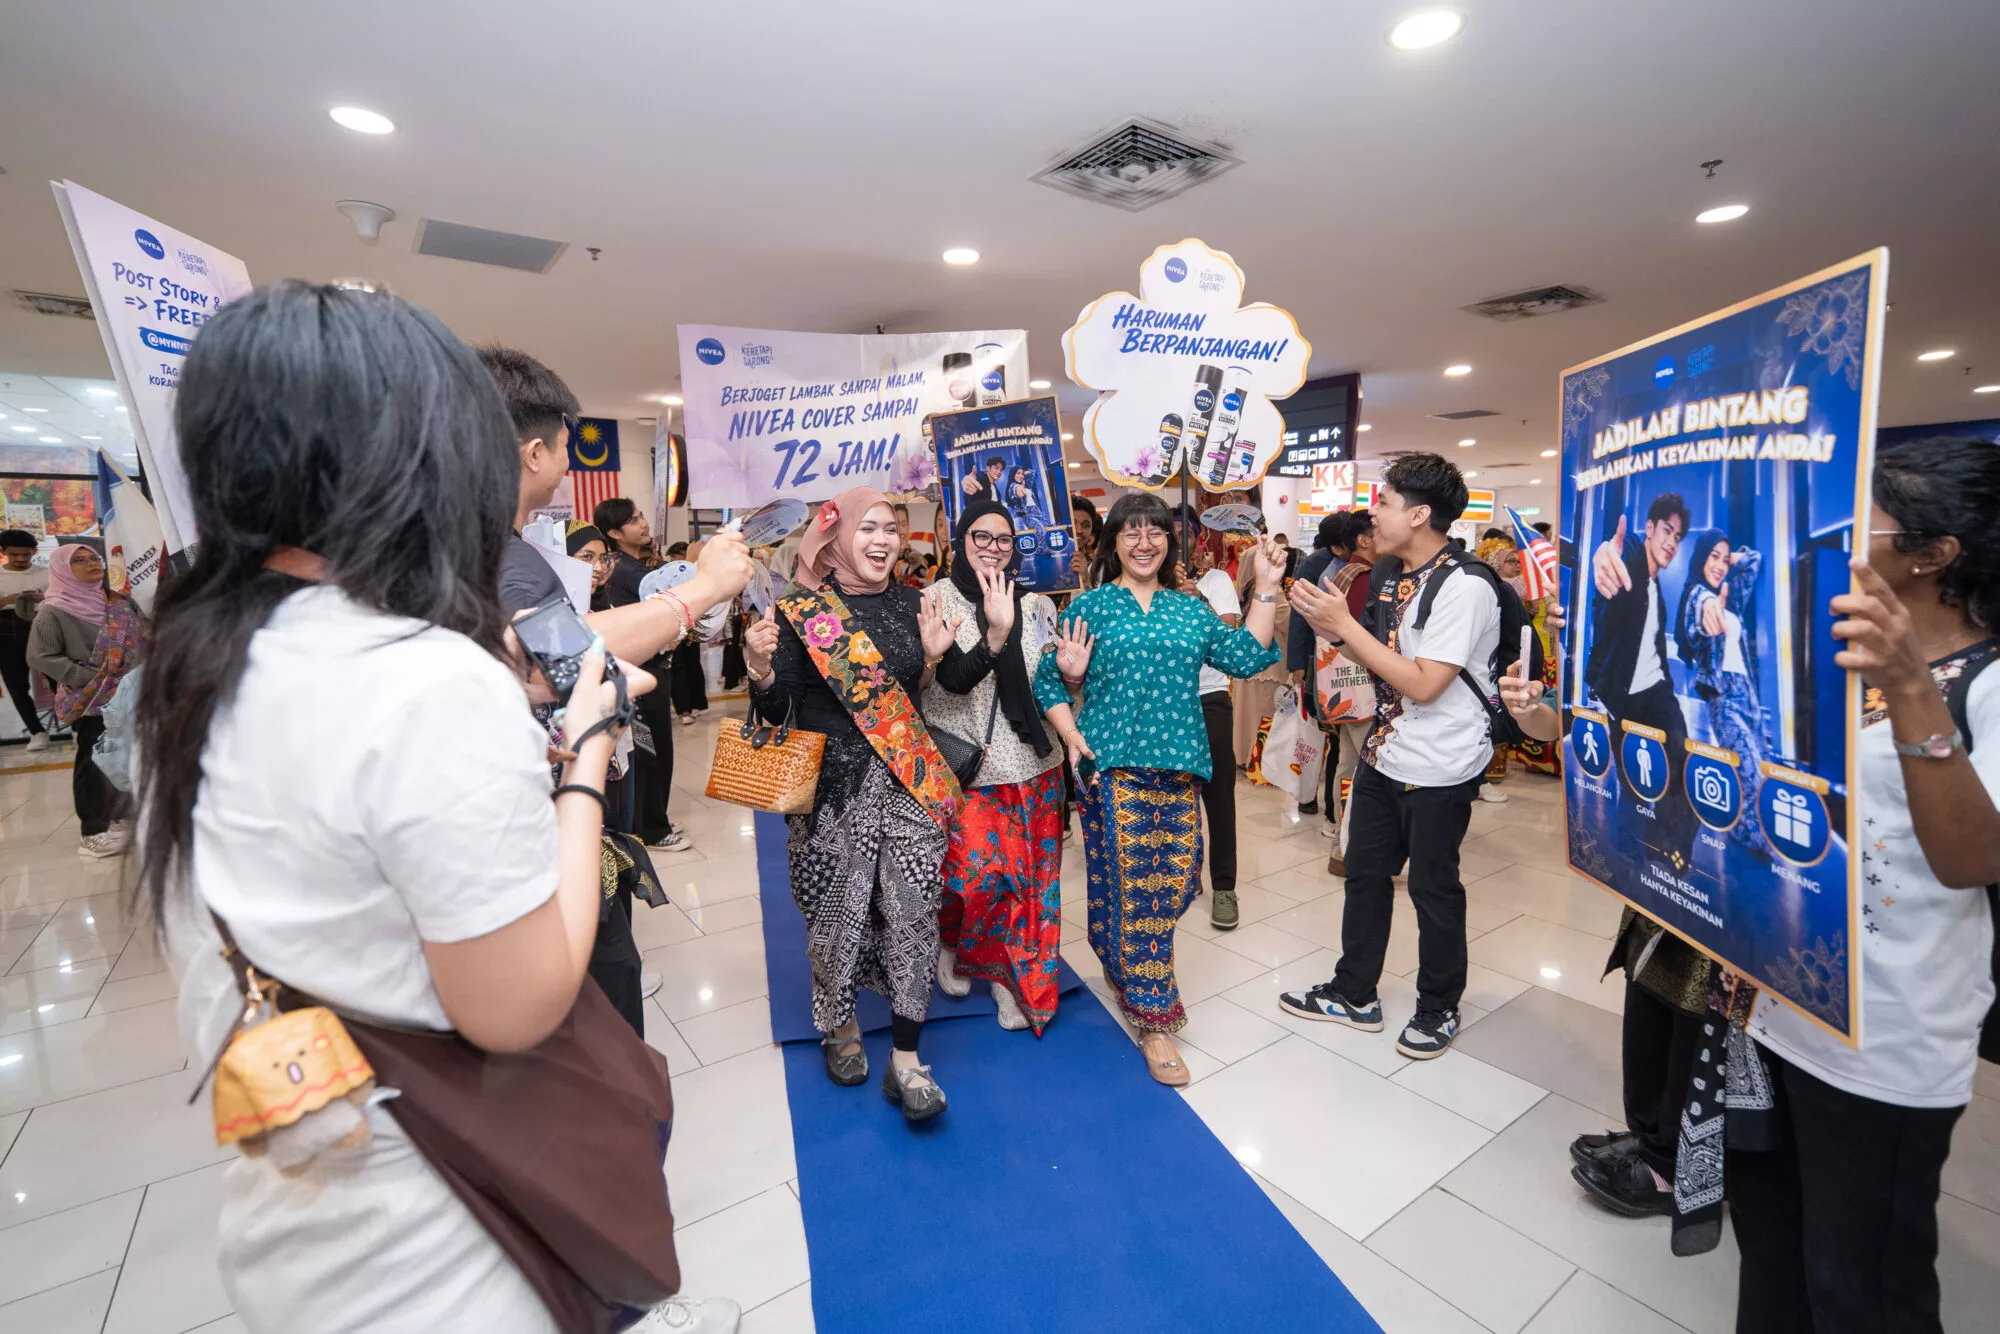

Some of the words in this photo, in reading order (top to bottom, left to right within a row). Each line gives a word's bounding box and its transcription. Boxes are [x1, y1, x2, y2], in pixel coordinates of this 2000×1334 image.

[137, 236, 162, 252] NIVEA
[1166, 265, 1185, 276] NIVEA
[112, 261, 154, 290] POST
[159, 277, 208, 308] STORY
[1112, 303, 1207, 331] HARUMAN
[147, 332, 192, 351] @MYNIVE
[698, 348, 723, 357] NIVEA
[741, 345, 773, 356] KERETAPI
[1120, 328, 1288, 363] BERPANJANGAN!
[743, 356, 771, 369] SARONG
[720, 386, 786, 406] BERJOGET
[790, 384, 834, 400] LAMBAK
[839, 378, 881, 396] SAMPAI
[886, 371, 926, 389] MALAM,
[1196, 395, 1212, 404] NIVEA
[1224, 398, 1240, 406] NIVEA
[728, 408, 795, 441] NIVEA
[801, 405, 856, 430] COVER
[861, 397, 919, 422] SAMPAI
[1592, 404, 1680, 459] JADILAH
[1684, 386, 1809, 433] BINTANG
[954, 428, 995, 447] JADILAH
[997, 425, 1043, 438] BINTANG
[987, 438, 1028, 450] KEYAKINAN
[772, 439, 822, 489] 72
[828, 432, 901, 478] JAM!
[1576, 450, 1654, 491] SERLAHKAN
[1657, 435, 1757, 468] KEYAKINAN
[1758, 434, 1836, 463] ANDA!
[1315, 464, 1348, 487] KK
[1335, 666, 1352, 677] THE
[1355, 665, 1368, 675] AR
[1574, 777, 1612, 799] MELANGKAH
[1636, 804, 1656, 820] GAYA
[1701, 833, 1726, 850] SNAP
[1651, 864, 1677, 886] TIADA
[1677, 880, 1709, 905] KESAN
[1771, 863, 1821, 894] MENANG
[1640, 873, 1669, 898] HANYA
[1670, 892, 1724, 929] KEYAKINAN
